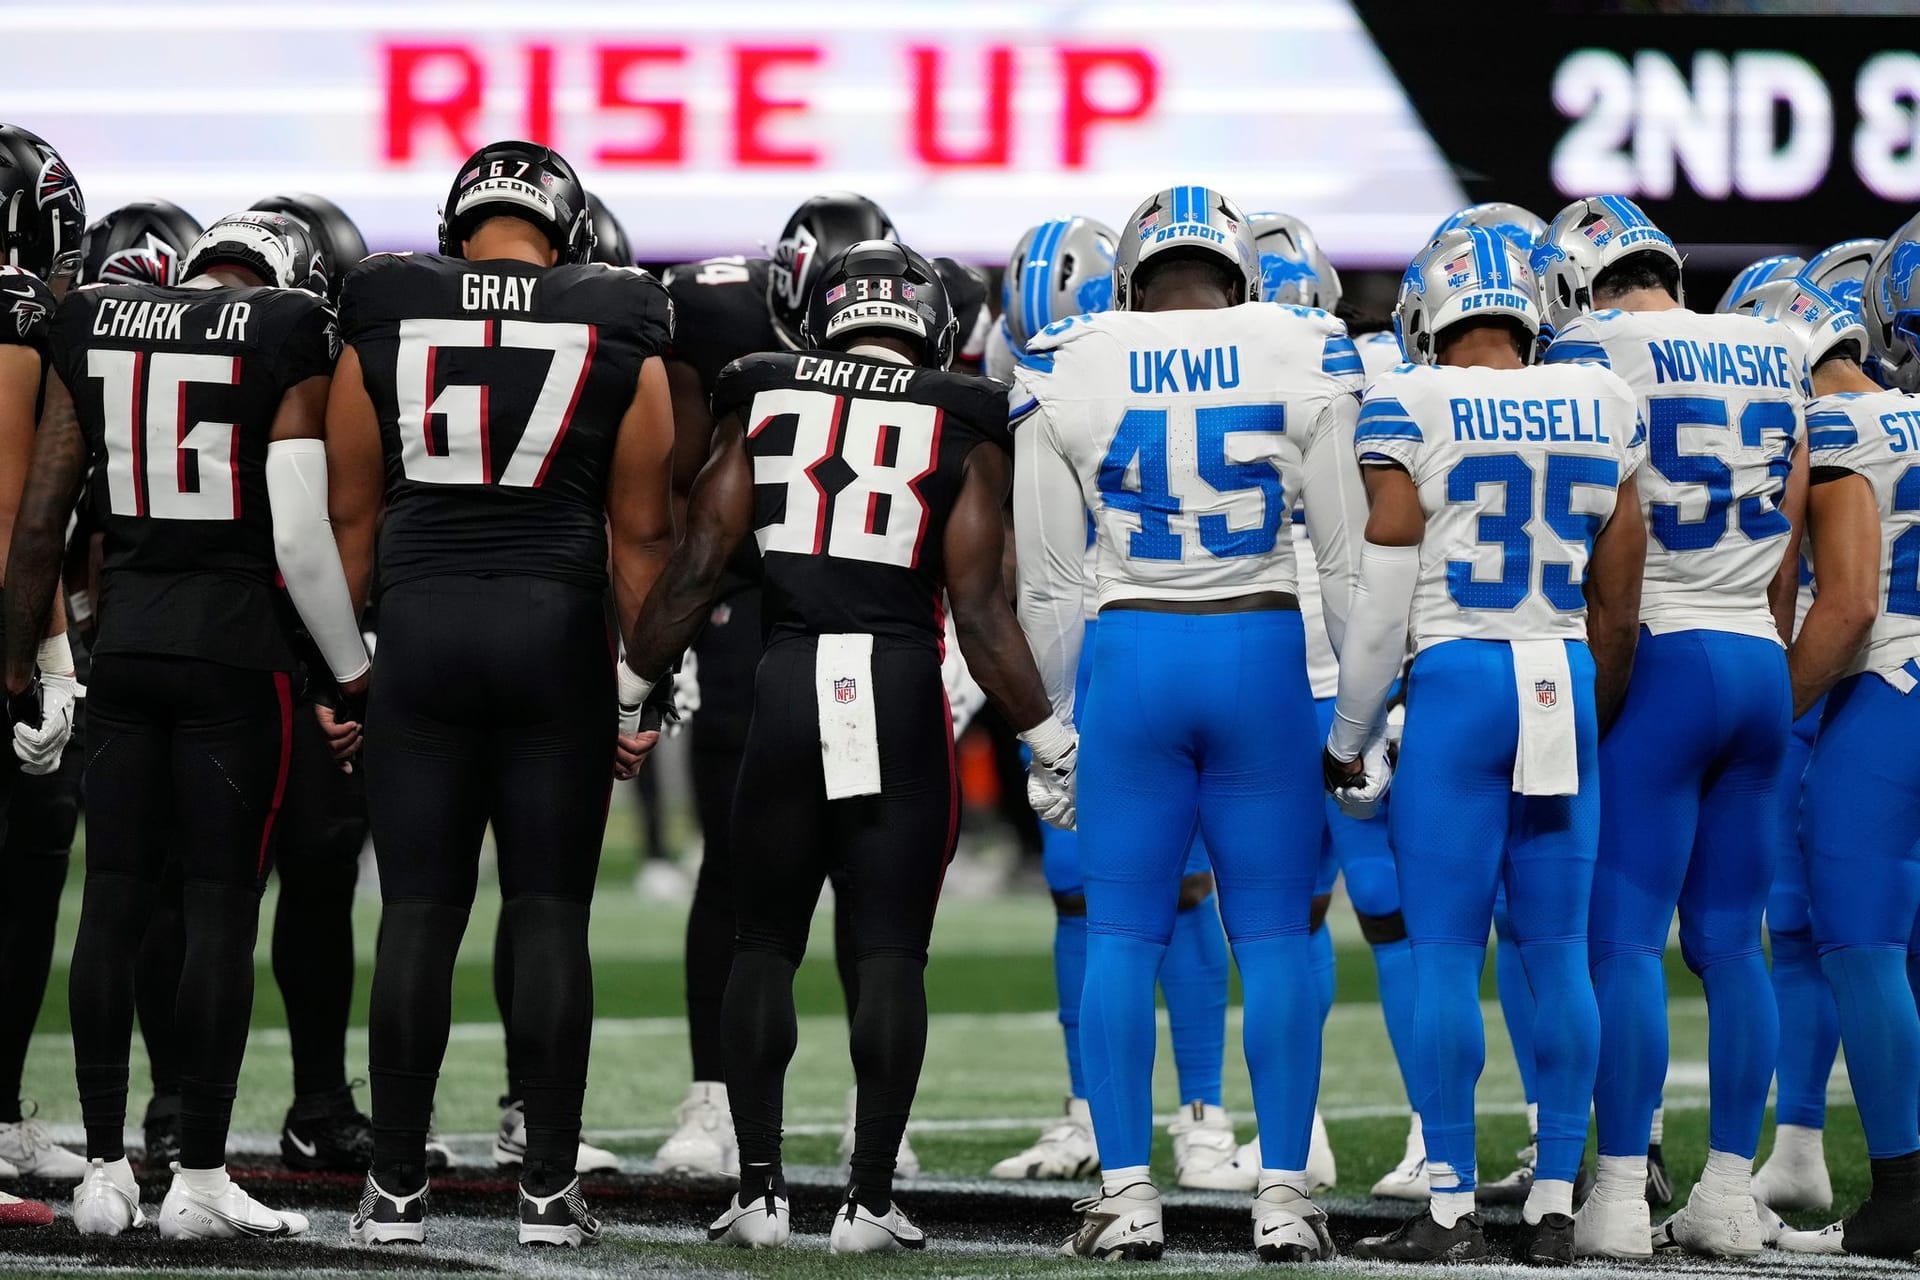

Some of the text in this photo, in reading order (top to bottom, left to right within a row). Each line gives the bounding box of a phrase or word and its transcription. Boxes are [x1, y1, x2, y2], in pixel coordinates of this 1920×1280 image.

[382, 43, 1158, 166] RISE UP
[1551, 48, 1834, 200] 2ND
[489, 160, 530, 177] 67
[461, 180, 548, 205] FALCONS
[1155, 225, 1226, 244] DETROIT
[1593, 230, 1613, 247] WCF
[462, 273, 537, 312] GRAY
[856, 279, 893, 301] 38
[1447, 272, 1470, 288] WCF
[93, 298, 251, 342] CHARK JR
[831, 306, 919, 327] FALCONS
[1461, 293, 1529, 313] DETROIT
[794, 355, 916, 394] CARTER
[1129, 345, 1240, 394] UKWU
[1647, 339, 1791, 389] NOWASKE
[396, 319, 598, 488] 67
[1449, 398, 1610, 444] RUSSELL
[87, 349, 242, 521] 16
[746, 388, 945, 569] 38
[1095, 401, 1288, 564] 45
[1444, 451, 1620, 614] 35
[837, 688, 854, 701] NFL
[1538, 691, 1555, 704] NFL
